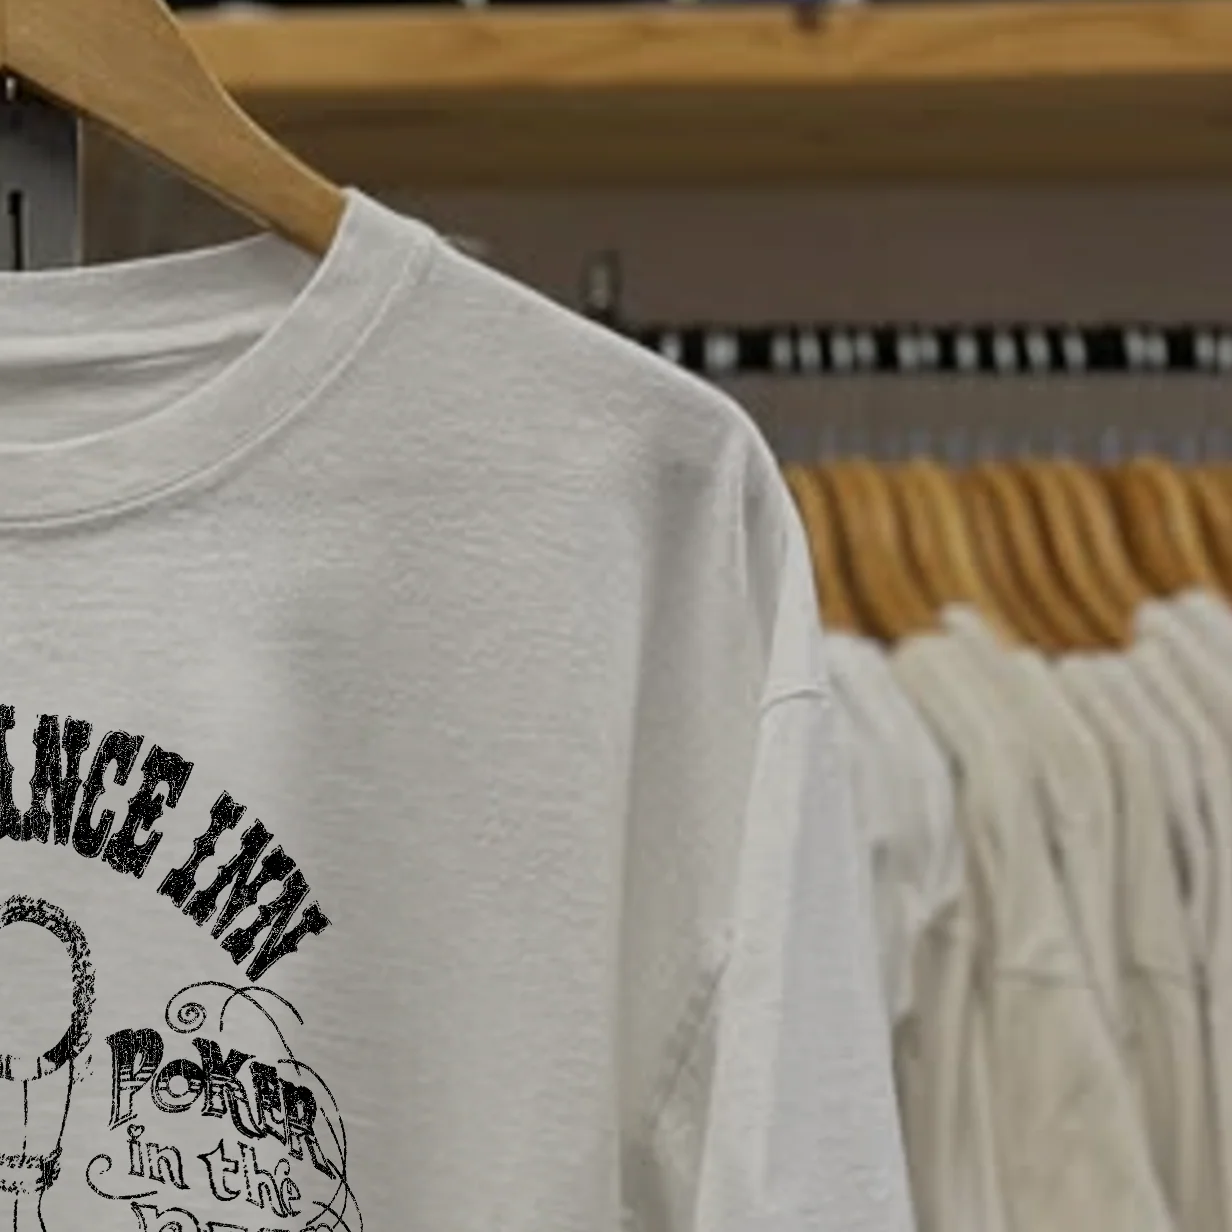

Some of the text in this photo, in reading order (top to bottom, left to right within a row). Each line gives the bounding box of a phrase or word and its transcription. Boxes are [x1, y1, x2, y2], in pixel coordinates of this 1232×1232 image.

[156, 790, 333, 982] INN
[105, 1027, 337, 1181] POKER
[126, 1123, 303, 1218] in the
